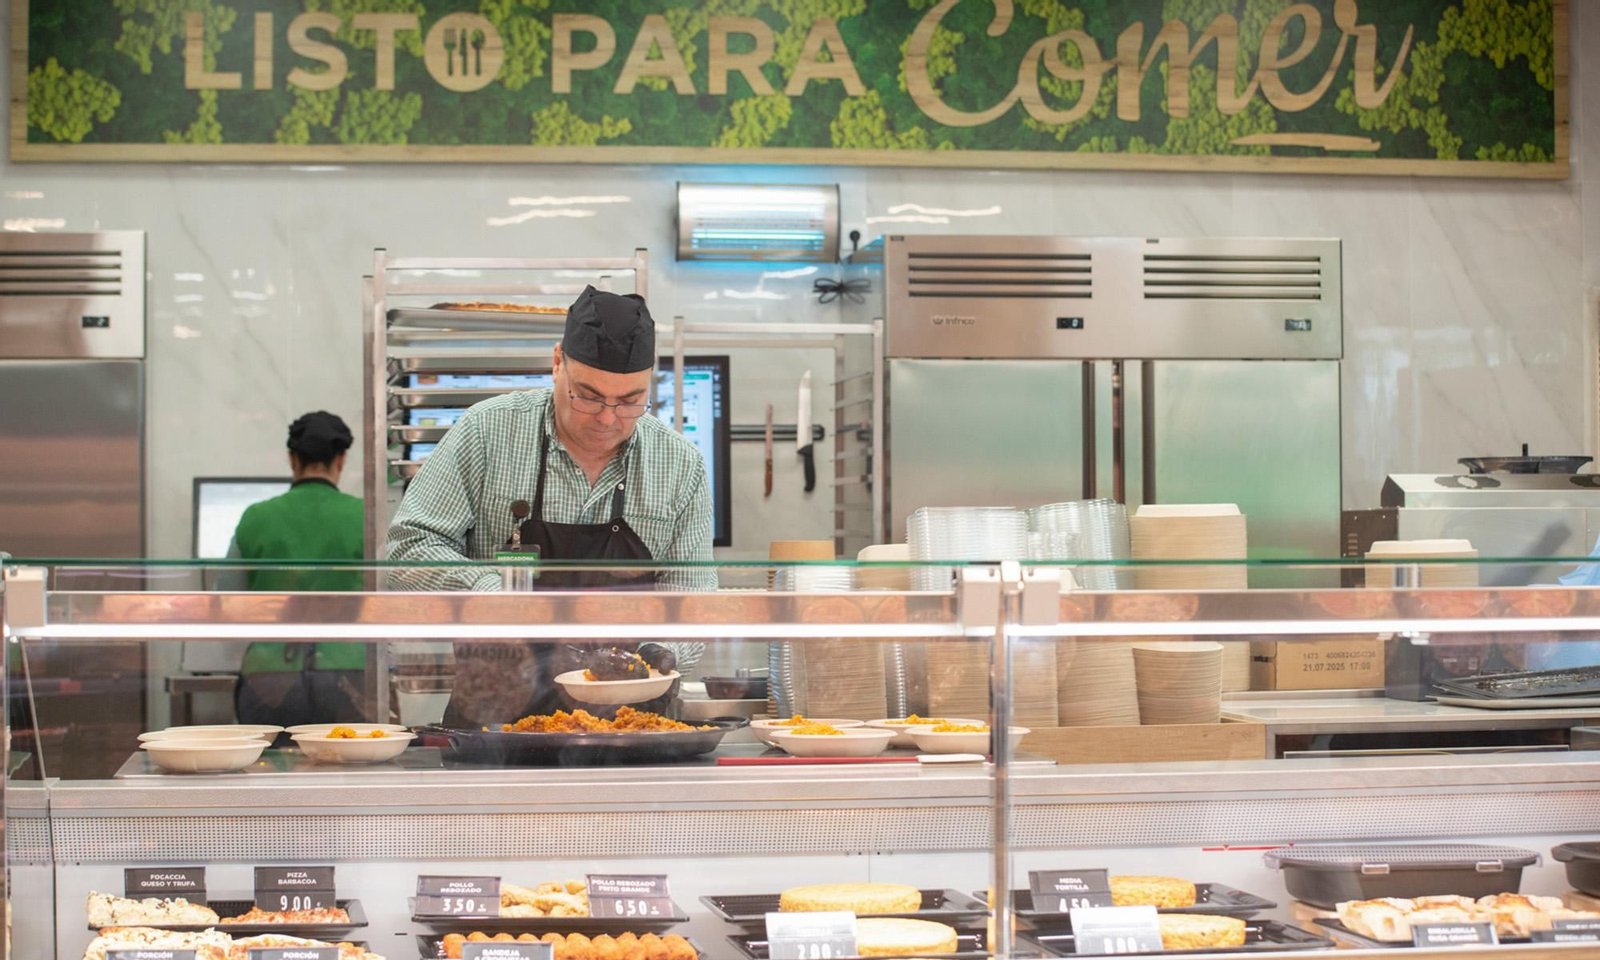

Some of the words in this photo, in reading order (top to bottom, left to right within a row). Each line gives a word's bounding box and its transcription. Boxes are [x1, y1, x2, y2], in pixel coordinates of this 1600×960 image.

[184, 11, 504, 92] LISTO
[552, 13, 868, 97] PARA
[904, 0, 1414, 127] Comer
[1303, 652, 1319, 660] 1473
[1303, 662, 1345, 672] 21.07.2025
[592, 879, 616, 887] POLLO
[616, 880, 656, 888] REBOZADO
[137, 950, 173, 960] PORCIÓN
[282, 950, 320, 960] PORCIÓN
[482, 948, 520, 957] BANDEJA
